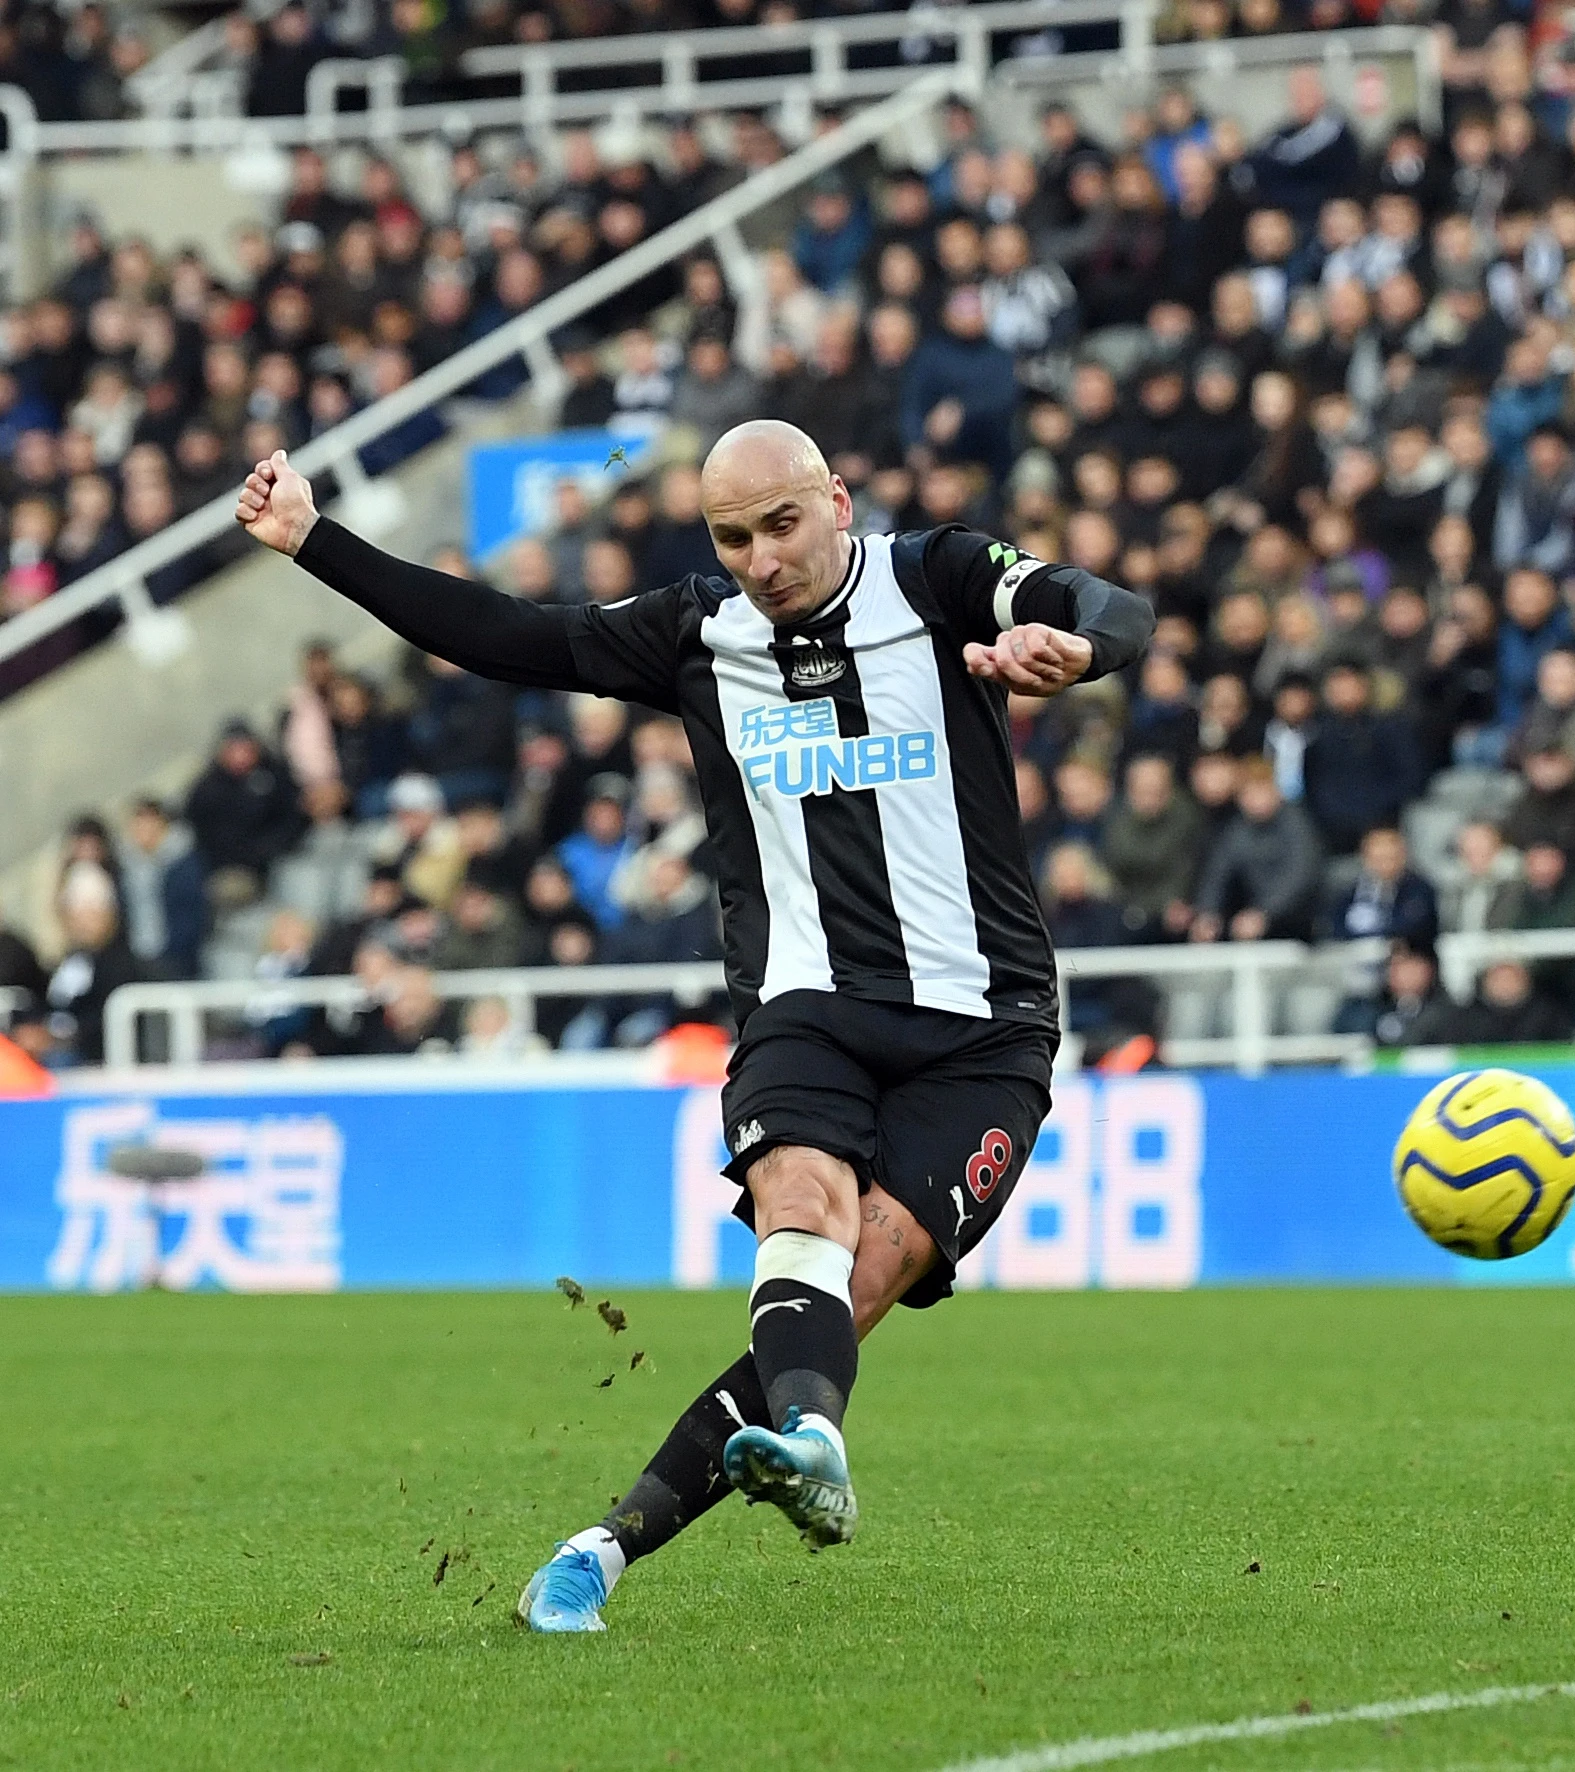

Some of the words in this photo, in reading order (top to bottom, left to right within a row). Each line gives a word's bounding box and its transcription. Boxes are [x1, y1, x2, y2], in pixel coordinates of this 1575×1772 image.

[739, 699, 836, 750] 乐天堂
[743, 730, 936, 802] FUN88
[966, 1127, 1013, 1203] 8
